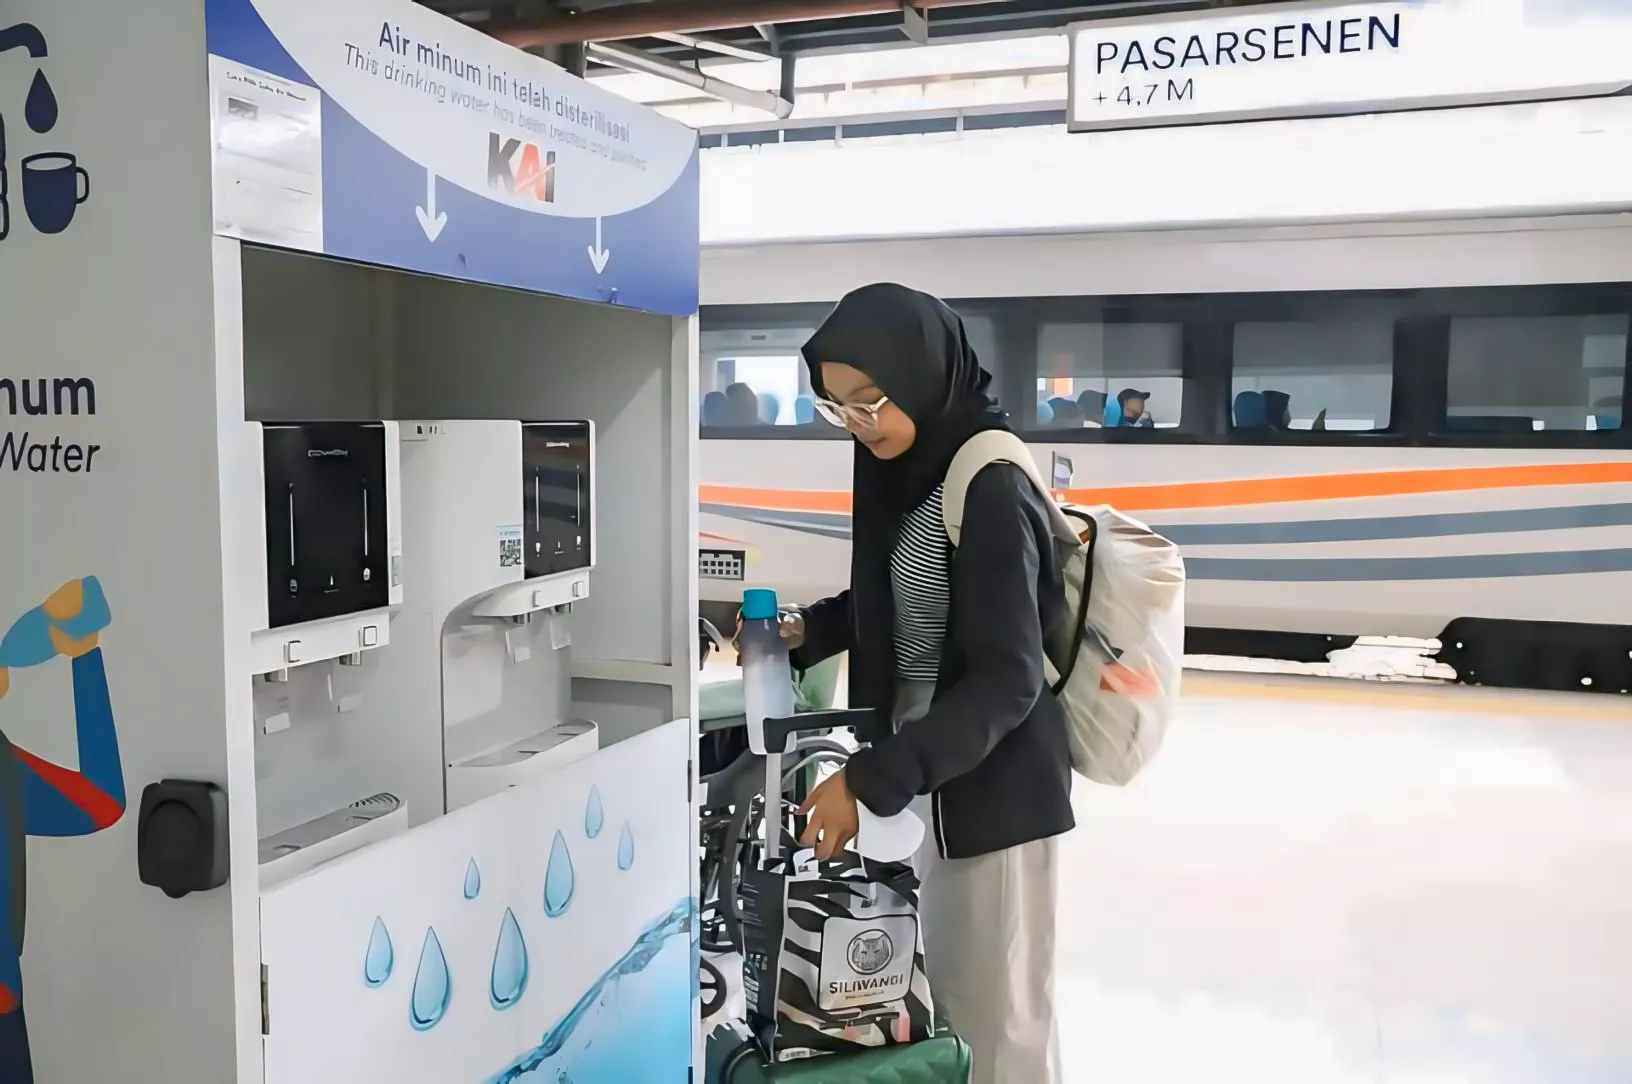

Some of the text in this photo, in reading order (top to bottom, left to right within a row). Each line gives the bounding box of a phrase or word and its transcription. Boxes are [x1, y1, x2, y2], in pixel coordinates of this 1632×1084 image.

[344, 42, 379, 76] This
[384, 59, 446, 104] drinking
[379, 21, 411, 56] Air
[416, 42, 481, 87] minum
[487, 64, 507, 96] ini
[513, 78, 551, 112] telah
[1096, 13, 1400, 75] PASARSENEN
[1116, 84, 1159, 108] 4,7
[487, 131, 556, 203] KAI
[0, 377, 96, 416] num
